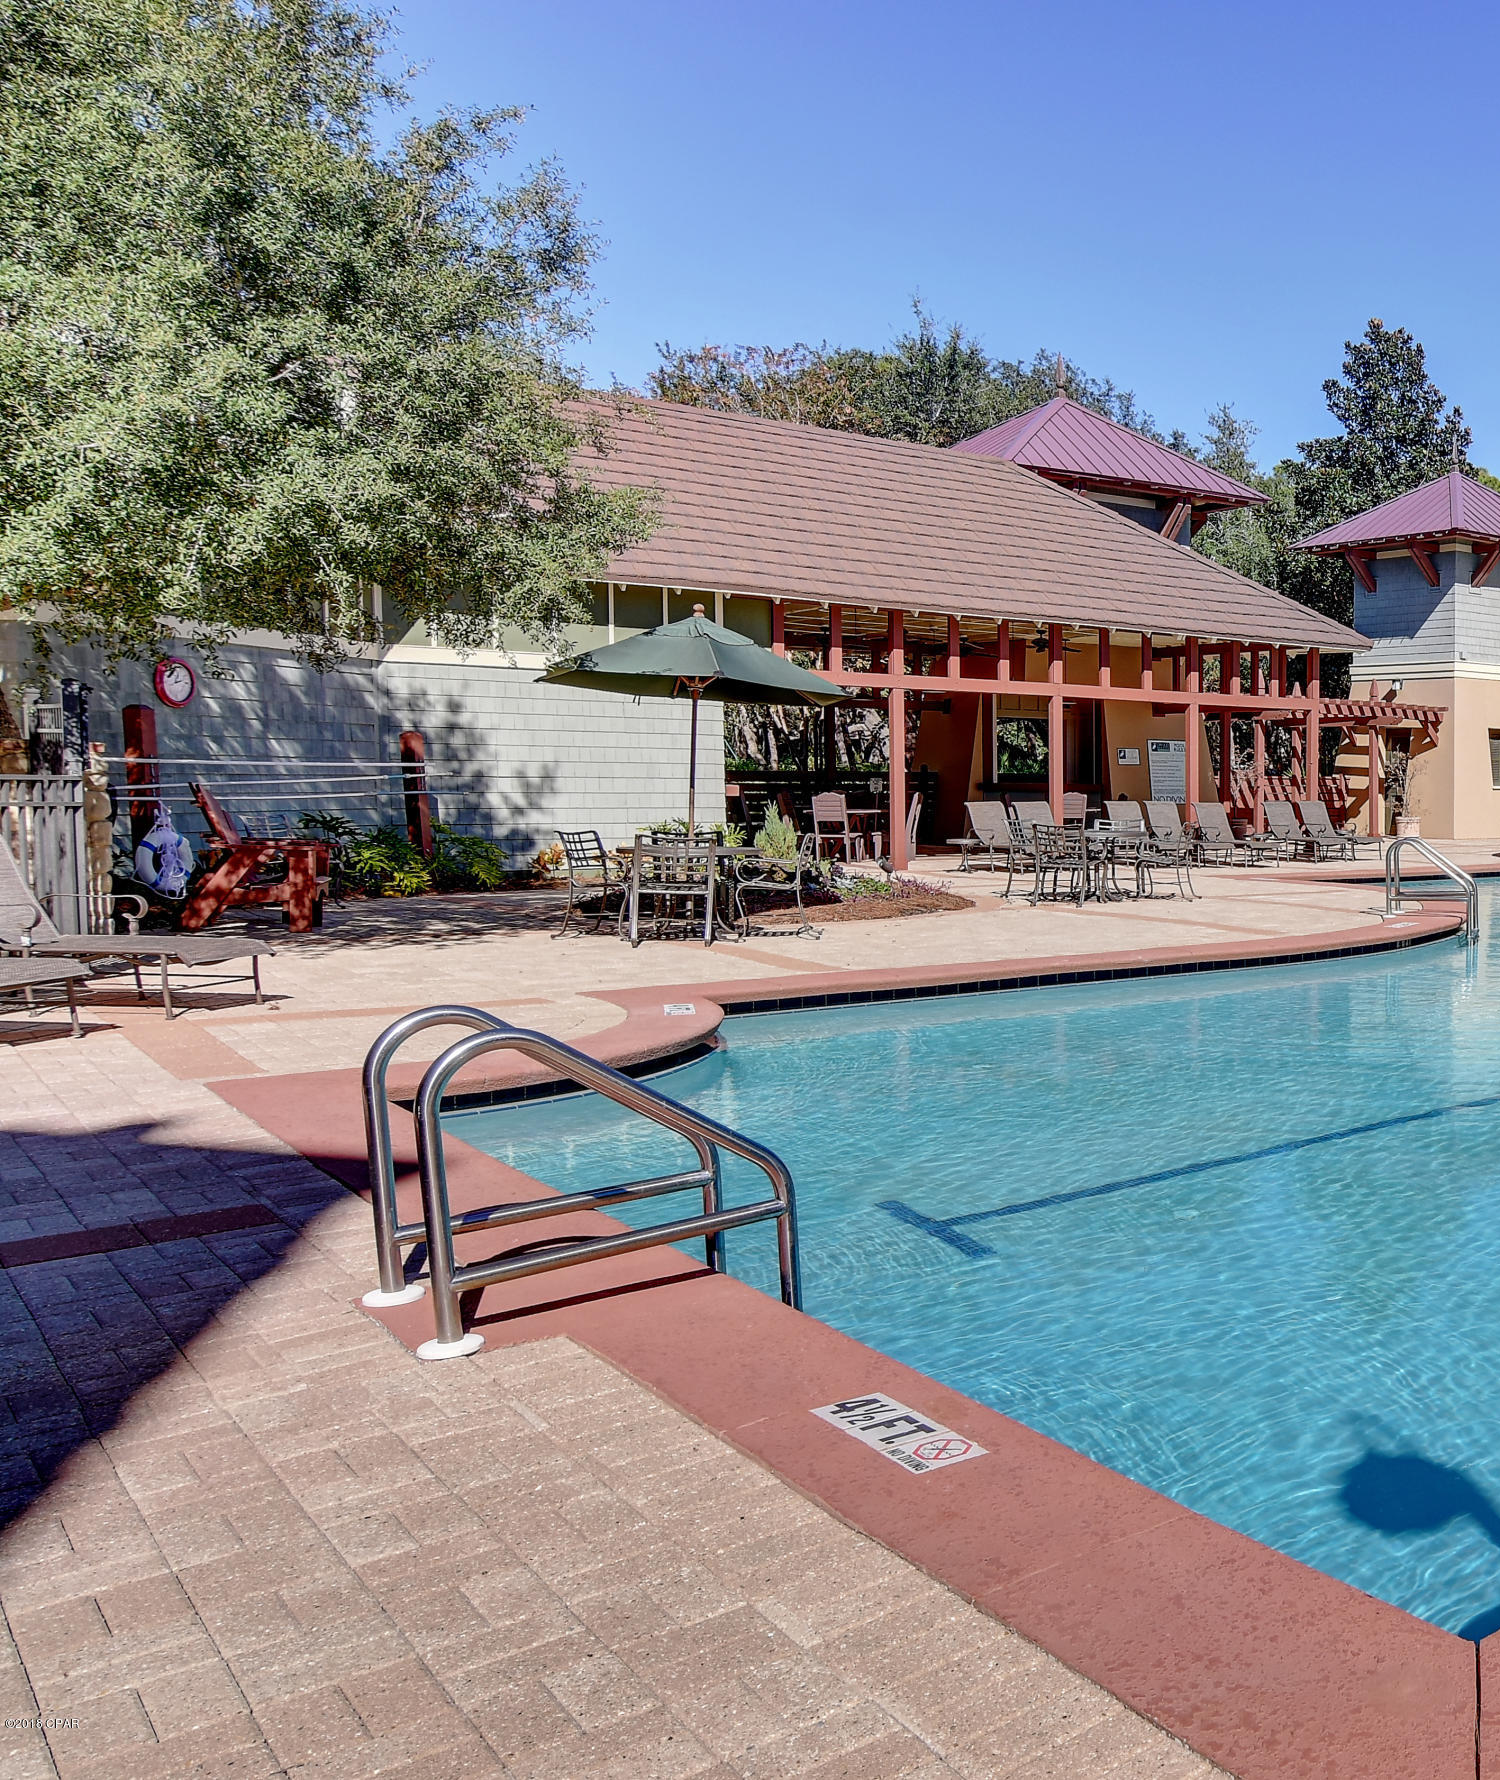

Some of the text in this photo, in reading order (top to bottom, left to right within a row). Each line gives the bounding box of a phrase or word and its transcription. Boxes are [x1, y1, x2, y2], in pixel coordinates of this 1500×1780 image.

[859, 1415, 937, 1445] FT.
[885, 1447, 930, 1472] NO DIVING
